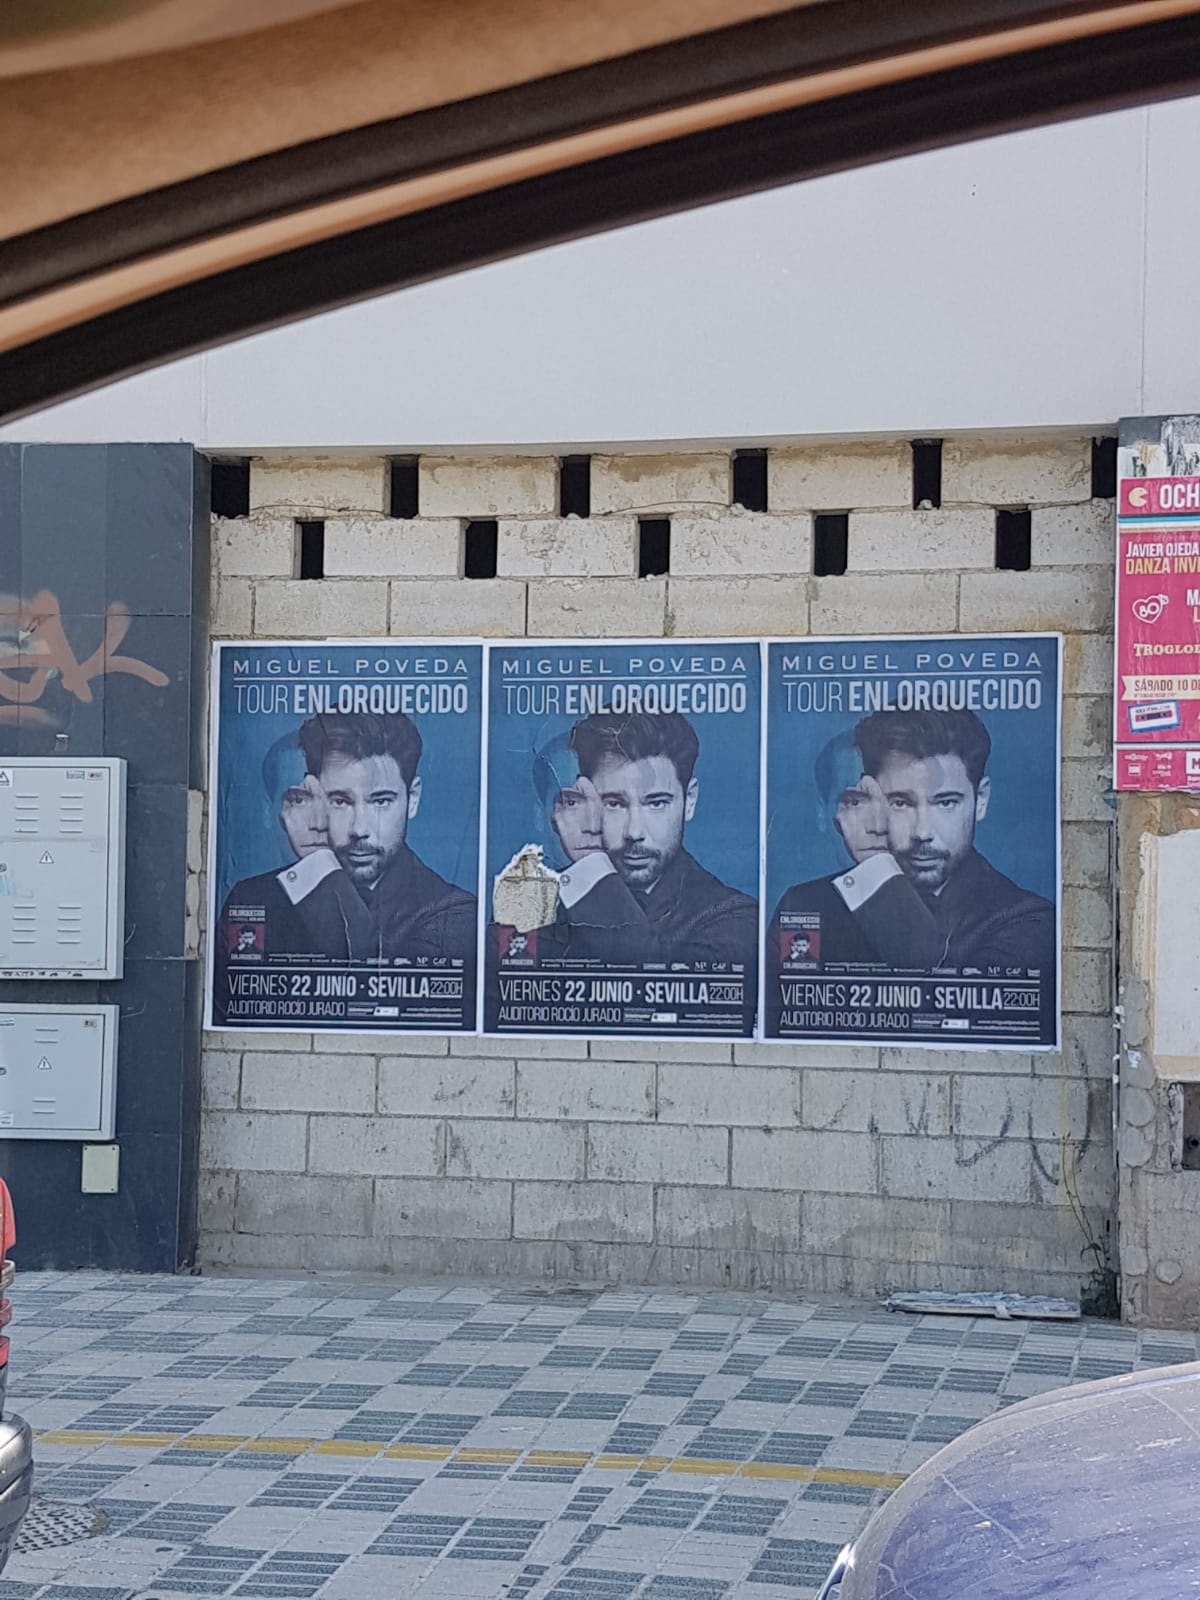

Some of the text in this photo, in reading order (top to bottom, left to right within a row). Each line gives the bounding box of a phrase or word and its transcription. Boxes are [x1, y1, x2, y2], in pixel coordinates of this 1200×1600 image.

[1126, 541, 1199, 557] JAVIER OJEDA
[1126, 557, 1170, 575] DANZA
[1187, 589, 1200, 606] M
[233, 659, 469, 674] MIGUEL POVEDA
[502, 657, 747, 674] MIGUEL POVEDA
[782, 652, 1042, 671] MIGUEL POVEDA
[1134, 677, 1173, 692] SÁBADO
[1177, 679, 1188, 691] 10
[233, 684, 469, 714] TOUR ENLORQUECIDO
[502, 682, 747, 715] TOUR ENLORQUECIDO
[782, 678, 1042, 713] TOUR ENLORQUECIDO
[228, 974, 288, 996] VIERNES
[291, 975, 311, 996] 22
[314, 975, 357, 997] JUNIO
[368, 976, 430, 998] SEVILLA
[499, 979, 561, 1001] VIERNES
[564, 980, 586, 1002] 22
[589, 981, 633, 1003] JUNIO
[645, 981, 709, 1004] SEVILLA
[780, 984, 846, 1006] VIERNES
[849, 985, 871, 1007] 22
[875, 986, 921, 1008] JUNIO
[934, 986, 1003, 1009] SEVILLA
[227, 1000, 277, 1016] AUDITORIO
[307, 1001, 345, 1017] JURADO
[498, 1005, 550, 1021] AUDITORIO
[551, 1004, 580, 1022] ROCÍO
[582, 1007, 621, 1023] JURADO
[780, 1010, 834, 1027] AUDITORIO
[835, 1009, 866, 1028] ROCÍO
[867, 1012, 909, 1029] JURADO
